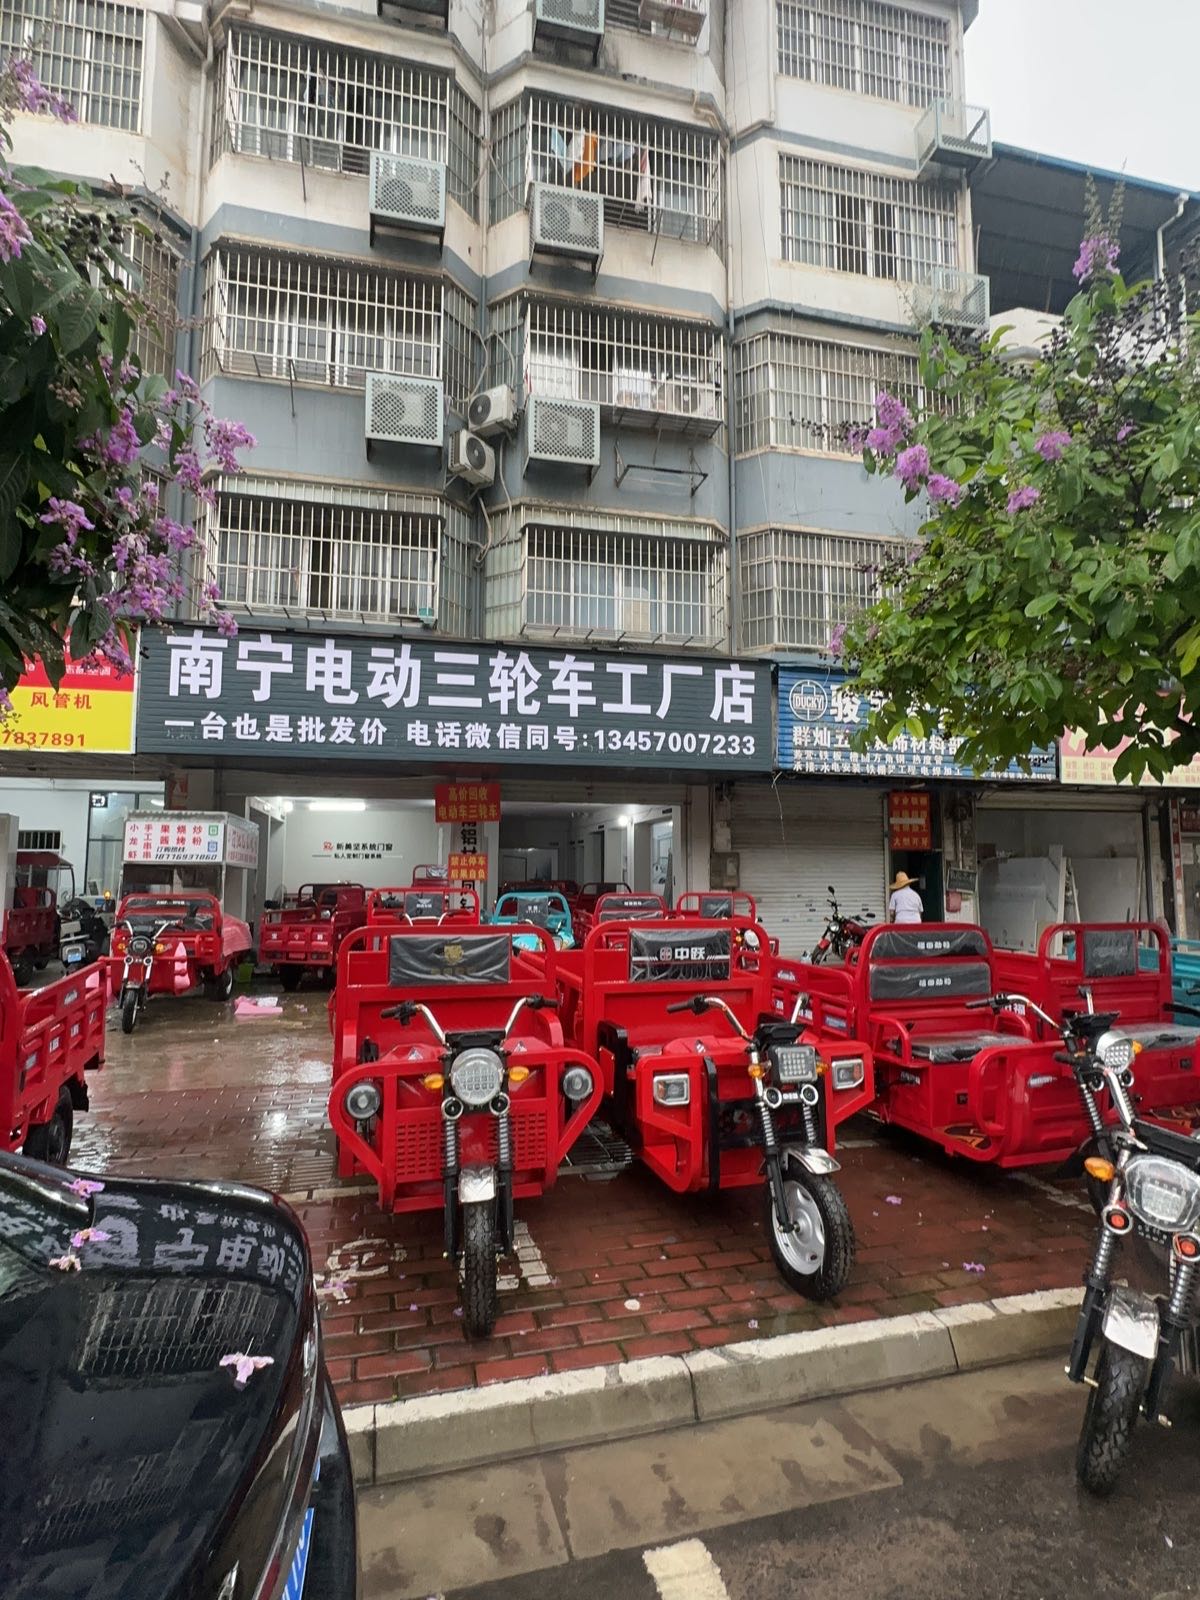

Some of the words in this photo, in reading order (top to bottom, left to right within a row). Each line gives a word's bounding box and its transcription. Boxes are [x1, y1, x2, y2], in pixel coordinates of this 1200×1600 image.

[166, 629, 756, 725] 南宁电动三轮车工厂店
[31, 692, 92, 710] 风管机
[795, 694, 823, 709] DUCKY
[164, 711, 388, 746] 一台也是批发价
[448, 786, 488, 801] 高价回收
[438, 803, 498, 819] 电动车三轮车
[450, 856, 486, 867] 禁止停车
[450, 867, 486, 879] 后果自负
